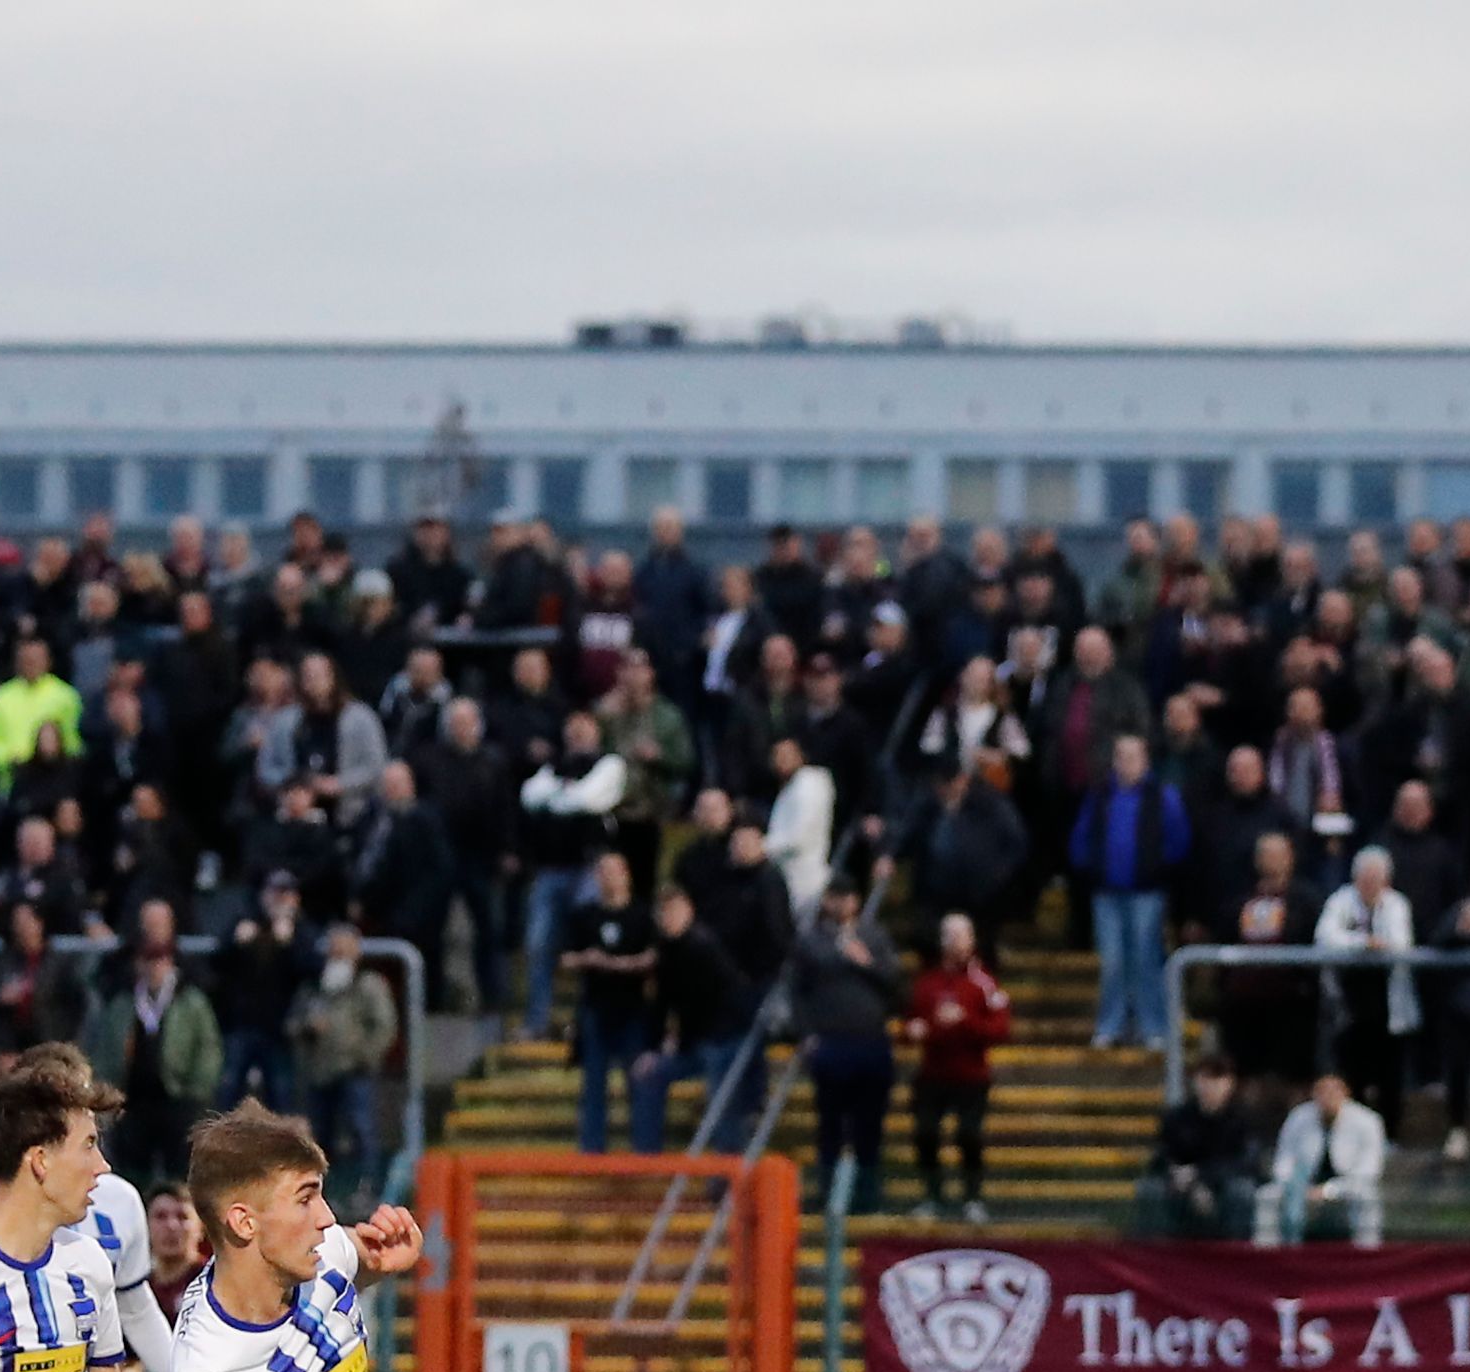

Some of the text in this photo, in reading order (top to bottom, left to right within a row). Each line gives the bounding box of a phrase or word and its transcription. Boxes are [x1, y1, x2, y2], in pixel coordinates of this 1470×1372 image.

[1063, 1290, 1251, 1368] There
[1273, 1298, 1334, 1368] Is
[1357, 1297, 1420, 1367] A
